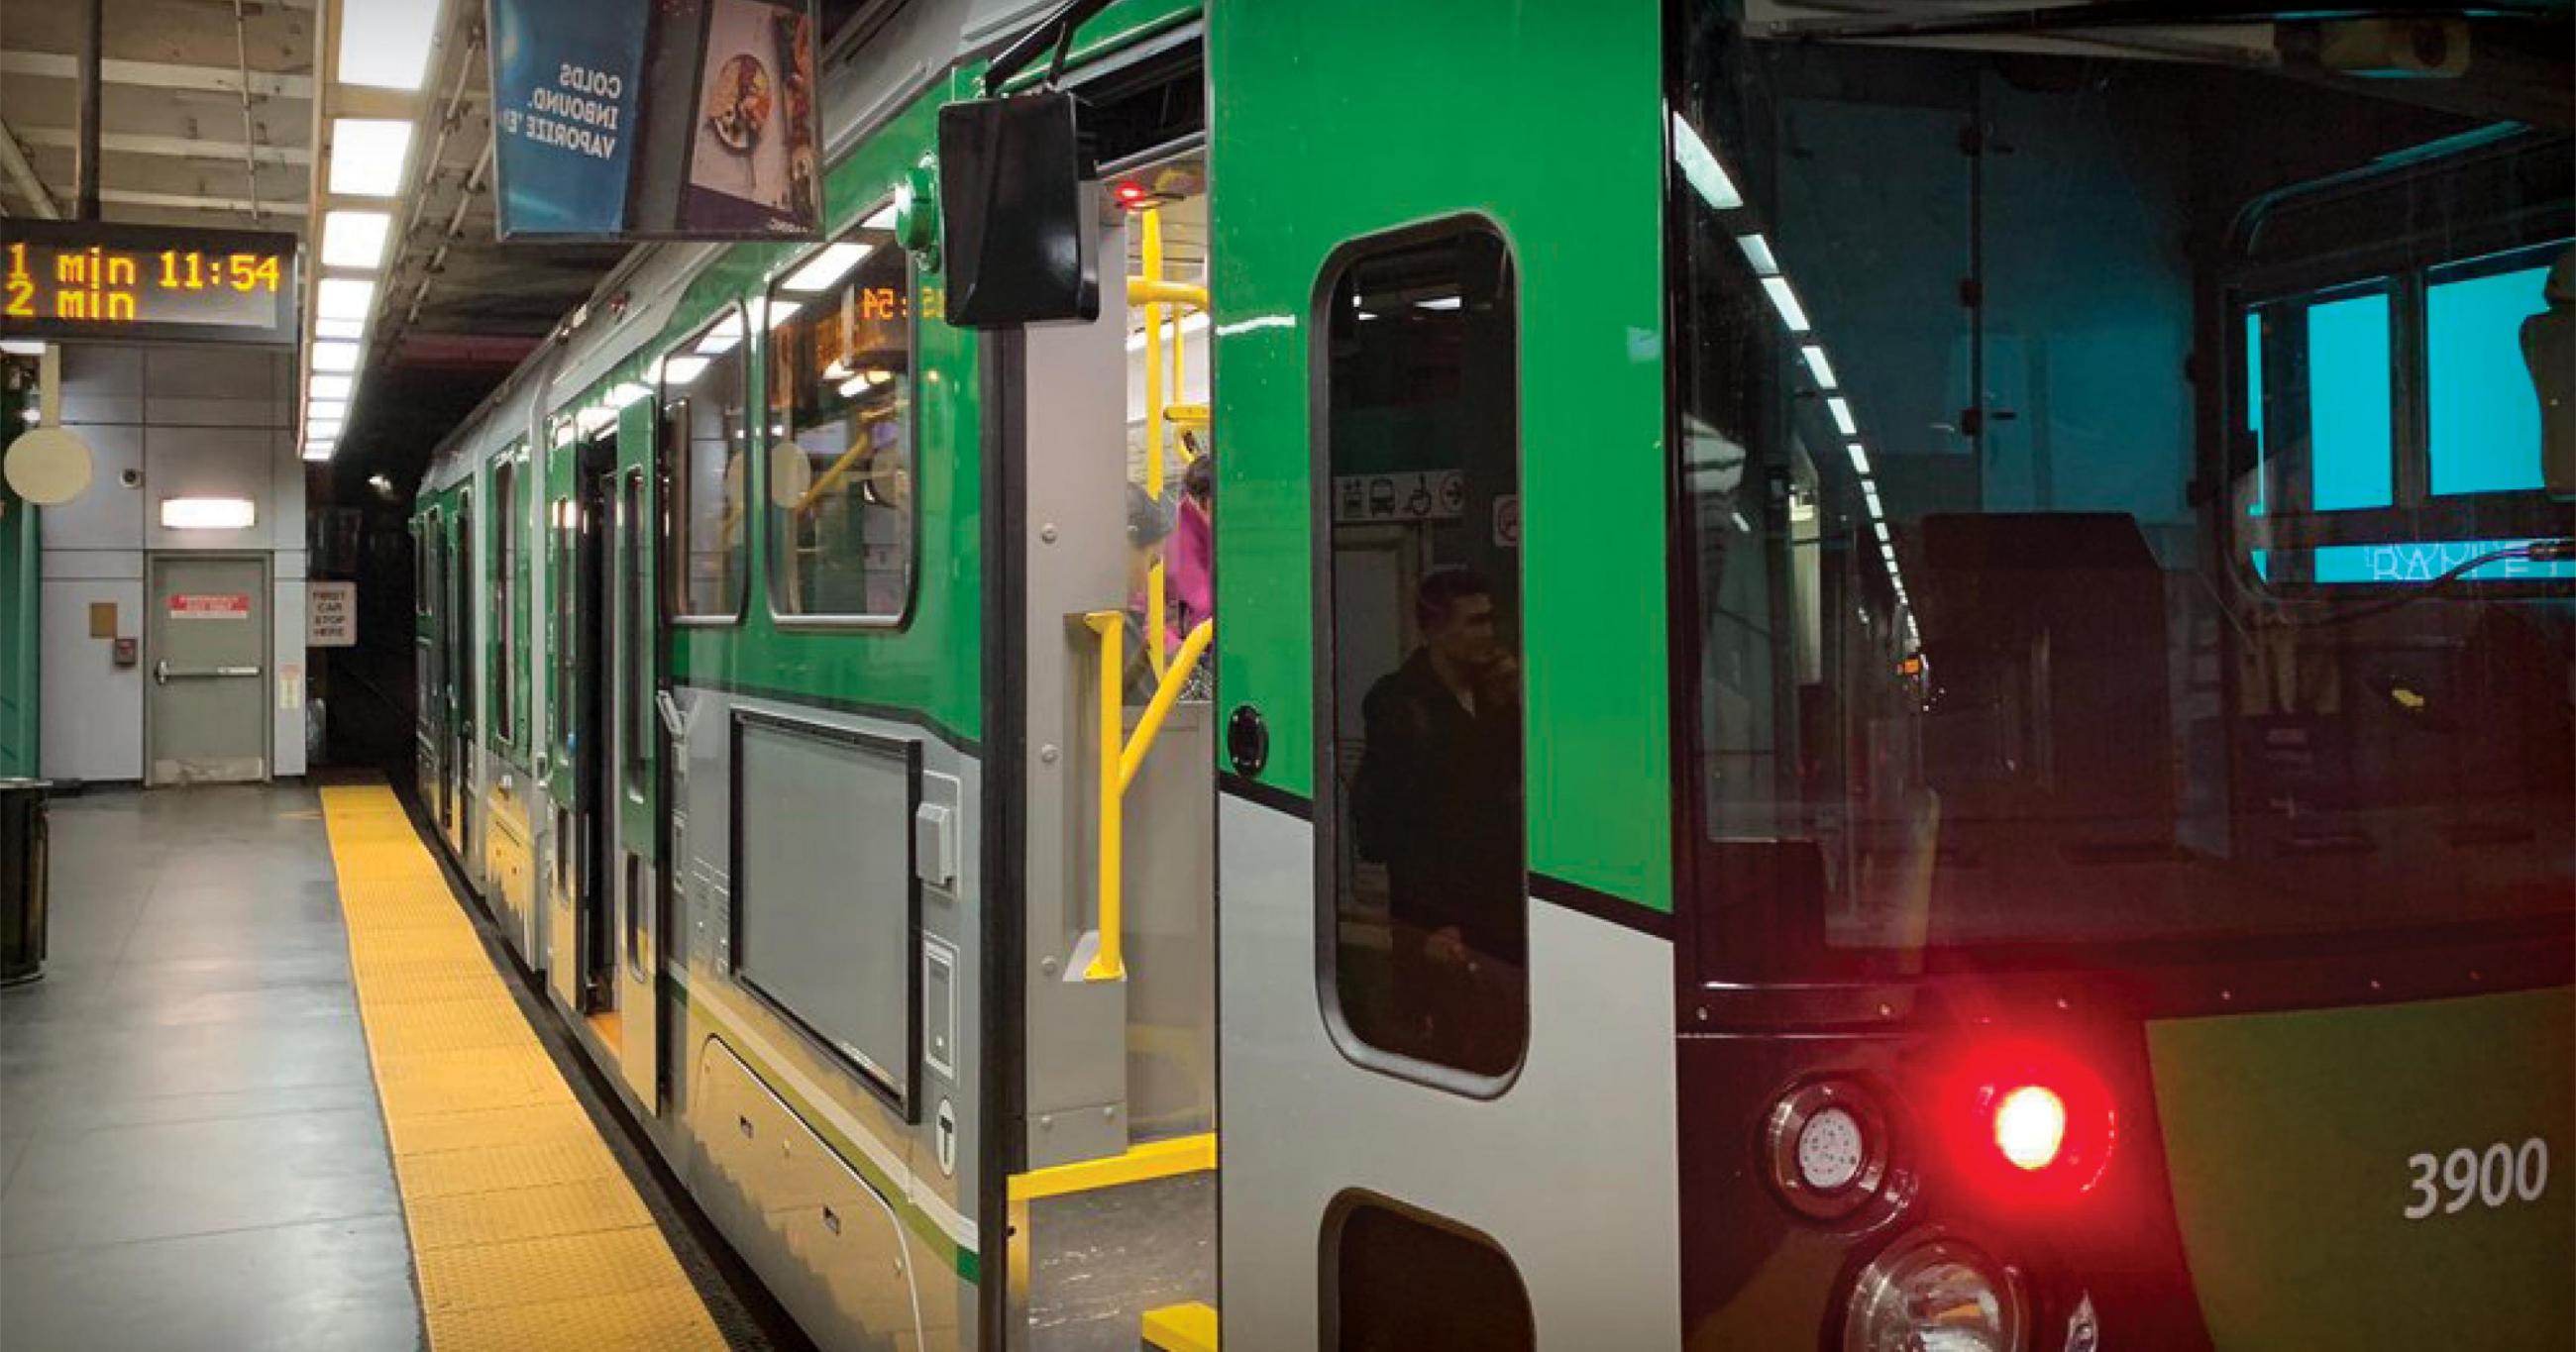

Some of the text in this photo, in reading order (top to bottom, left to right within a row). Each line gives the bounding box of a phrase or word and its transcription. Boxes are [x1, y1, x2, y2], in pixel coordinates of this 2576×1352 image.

[9, 242, 279, 292] 1 min 11:54
[6, 279, 136, 320] 2 min
[2404, 1137, 2548, 1219] 3900
